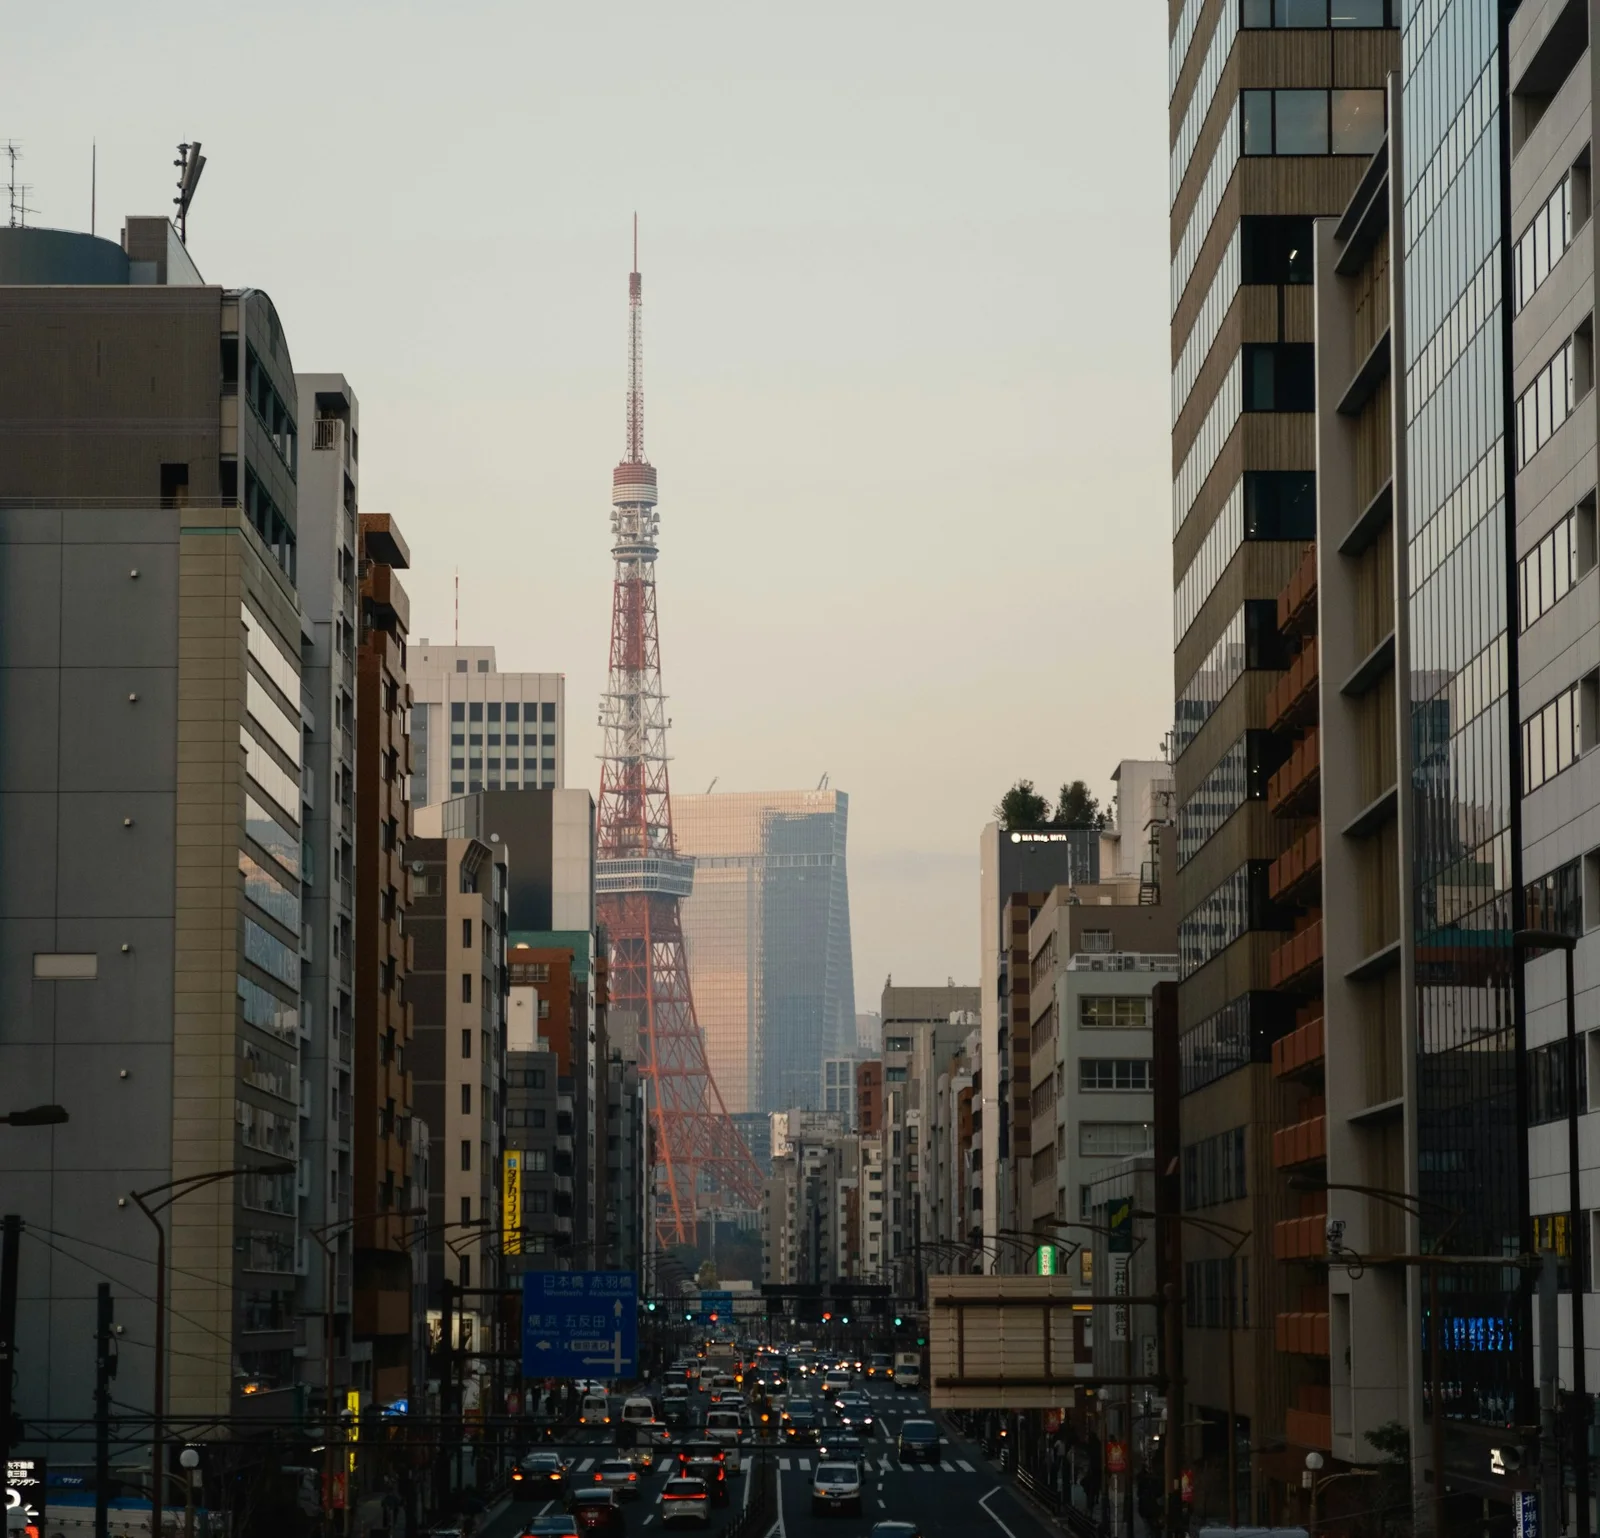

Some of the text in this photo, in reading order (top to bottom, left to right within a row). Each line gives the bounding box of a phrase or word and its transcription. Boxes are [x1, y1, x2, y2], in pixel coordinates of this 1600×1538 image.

[1050, 834, 1067, 842] MITA
[543, 1274, 633, 1289] 日本橋 赤羽橋
[527, 1314, 606, 1329] 横浜 五反田
[569, 1328, 601, 1337] Gotanda
